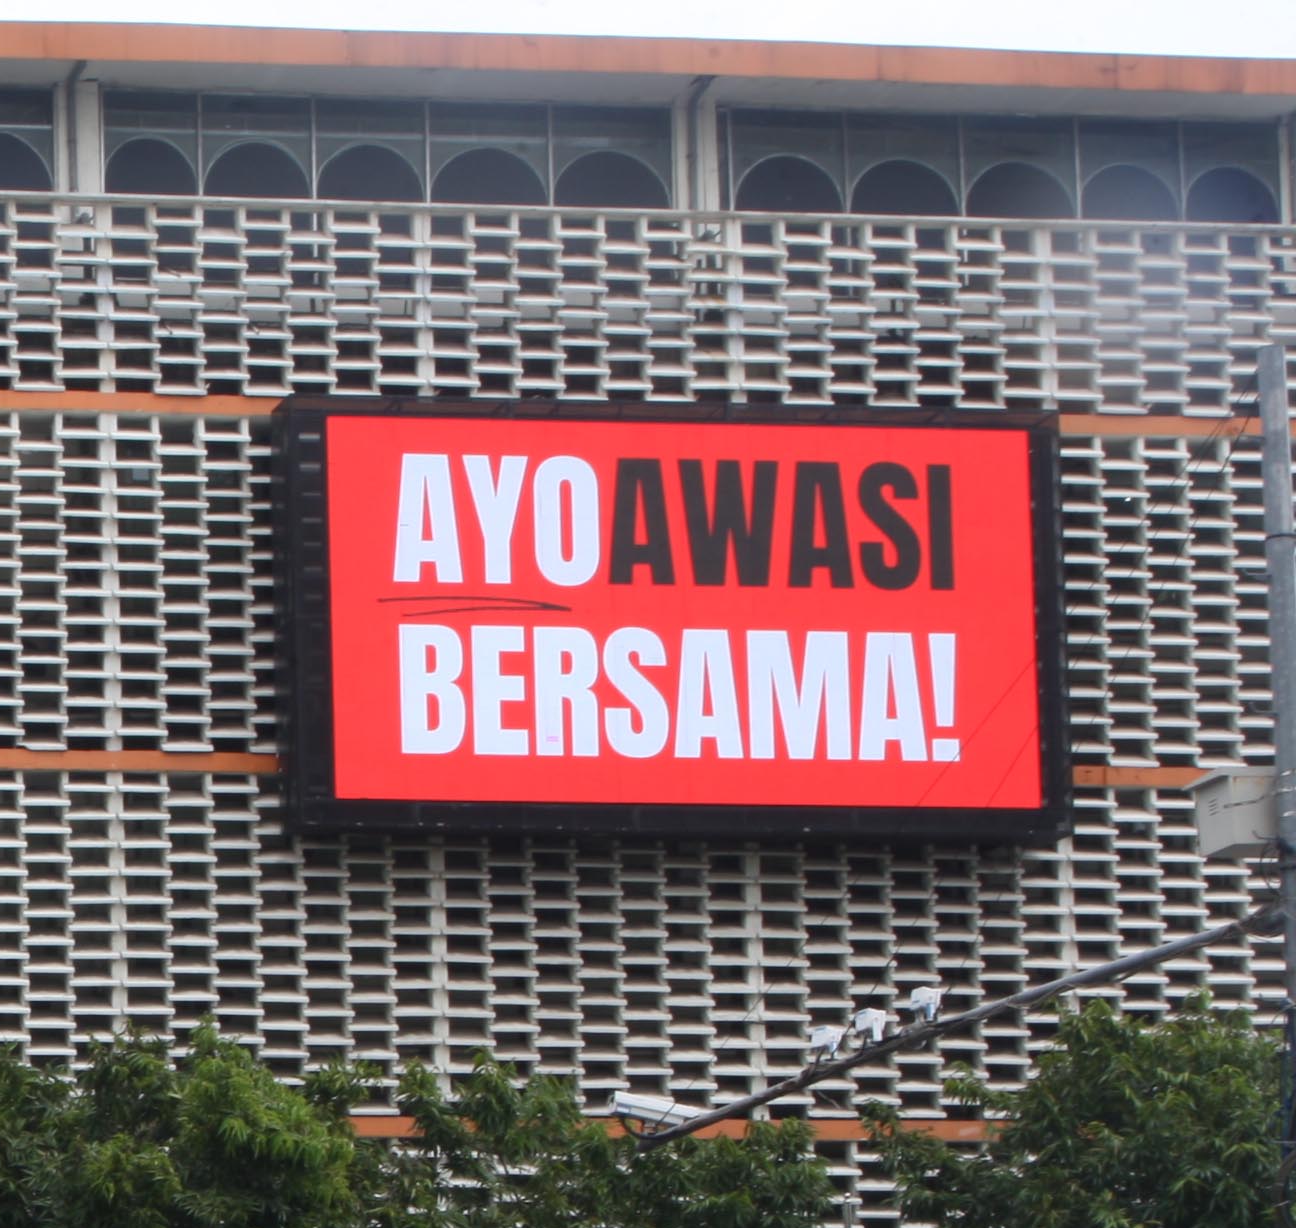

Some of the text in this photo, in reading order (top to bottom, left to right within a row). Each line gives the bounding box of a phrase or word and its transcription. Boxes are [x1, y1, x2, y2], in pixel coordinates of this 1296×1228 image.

[393, 453, 955, 591] AYO AWASI
[396, 623, 961, 763] BERSAMA!
